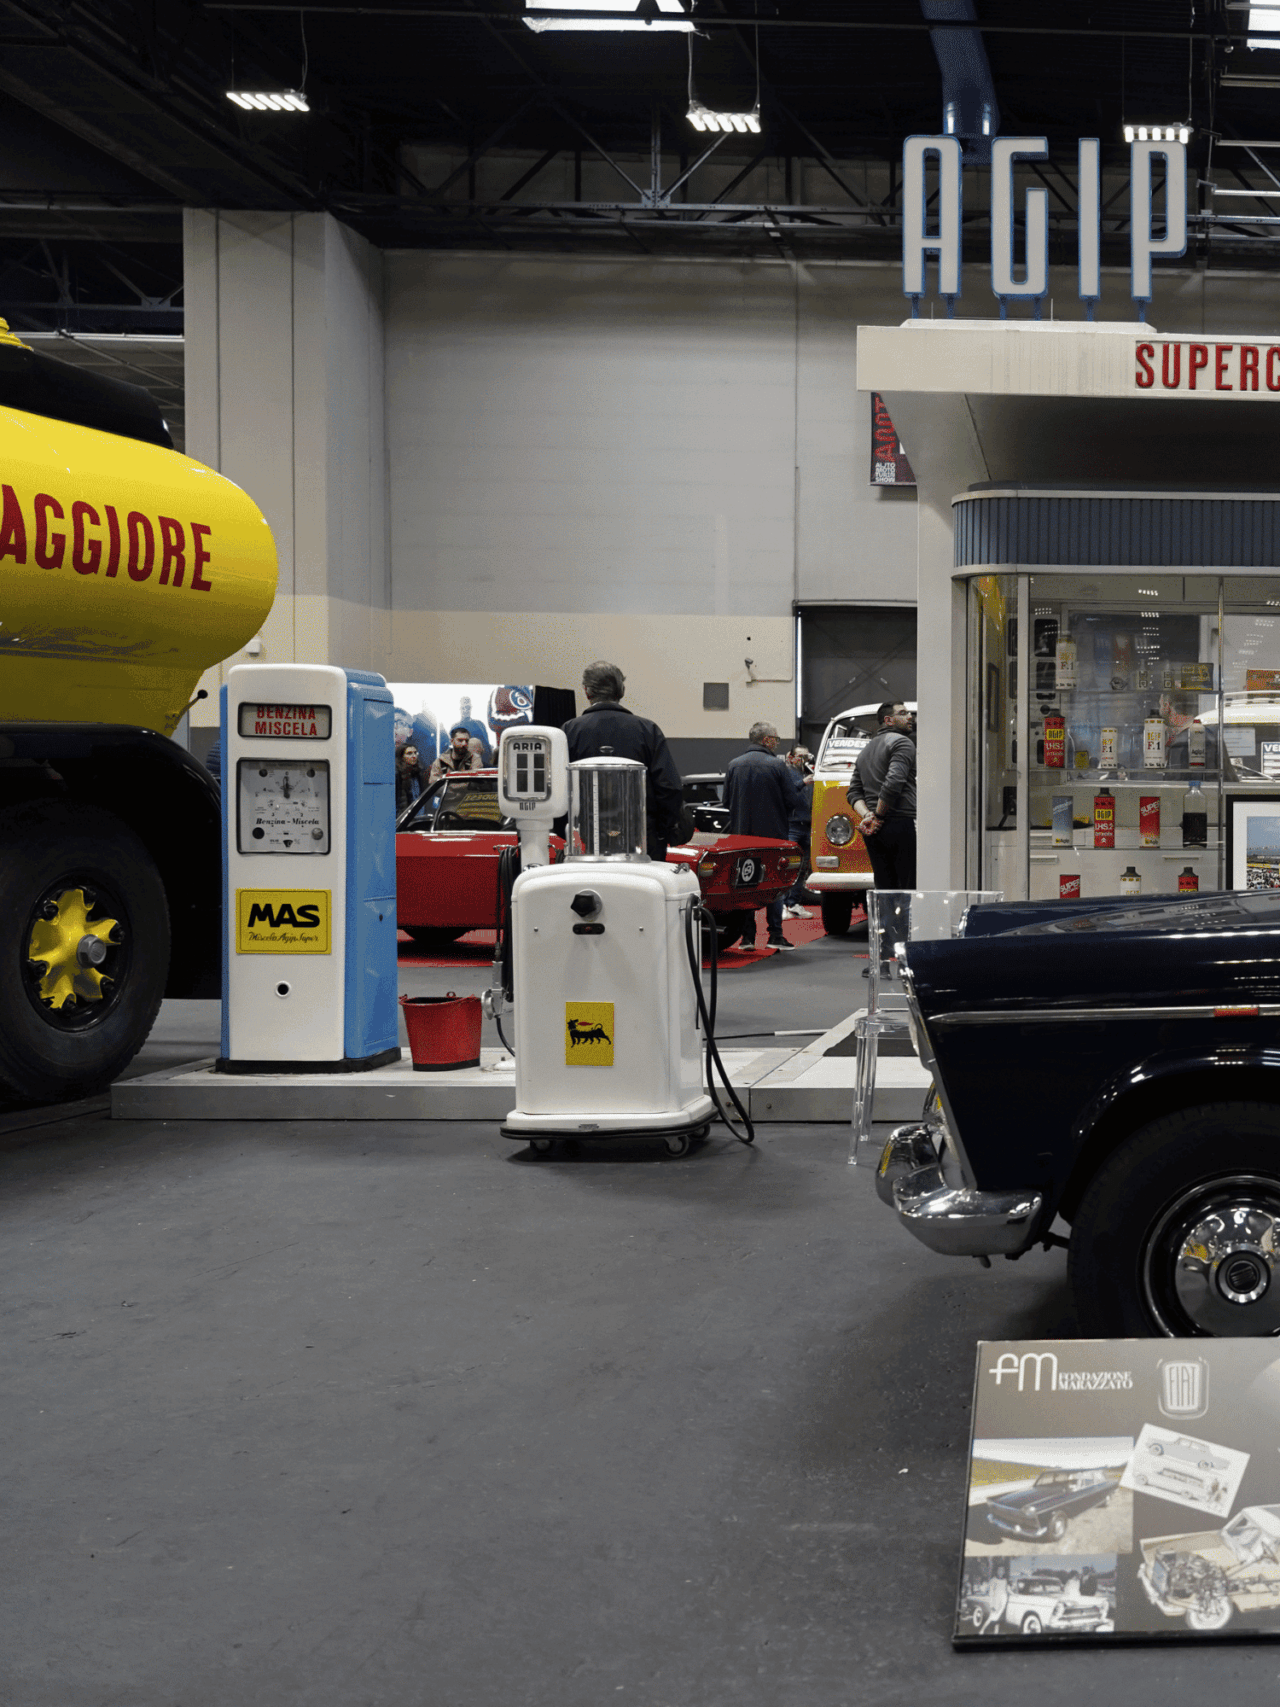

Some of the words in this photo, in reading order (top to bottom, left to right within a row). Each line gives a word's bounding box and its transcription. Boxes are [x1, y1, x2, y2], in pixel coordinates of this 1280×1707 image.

[903, 135, 1187, 299] AGIP
[257, 706, 316, 720] BENZINA
[255, 721, 318, 736] MISCELA
[513, 743, 542, 751] ARIA
[829, 740, 870, 748] VENDES
[519, 802, 536, 811] AGIP
[247, 903, 320, 928] MAS
[1058, 1371, 1132, 1381] FONDAZIONE
[1058, 1380, 1133, 1390] MARAZZATO
[1168, 1365, 1196, 1407] FIAT
